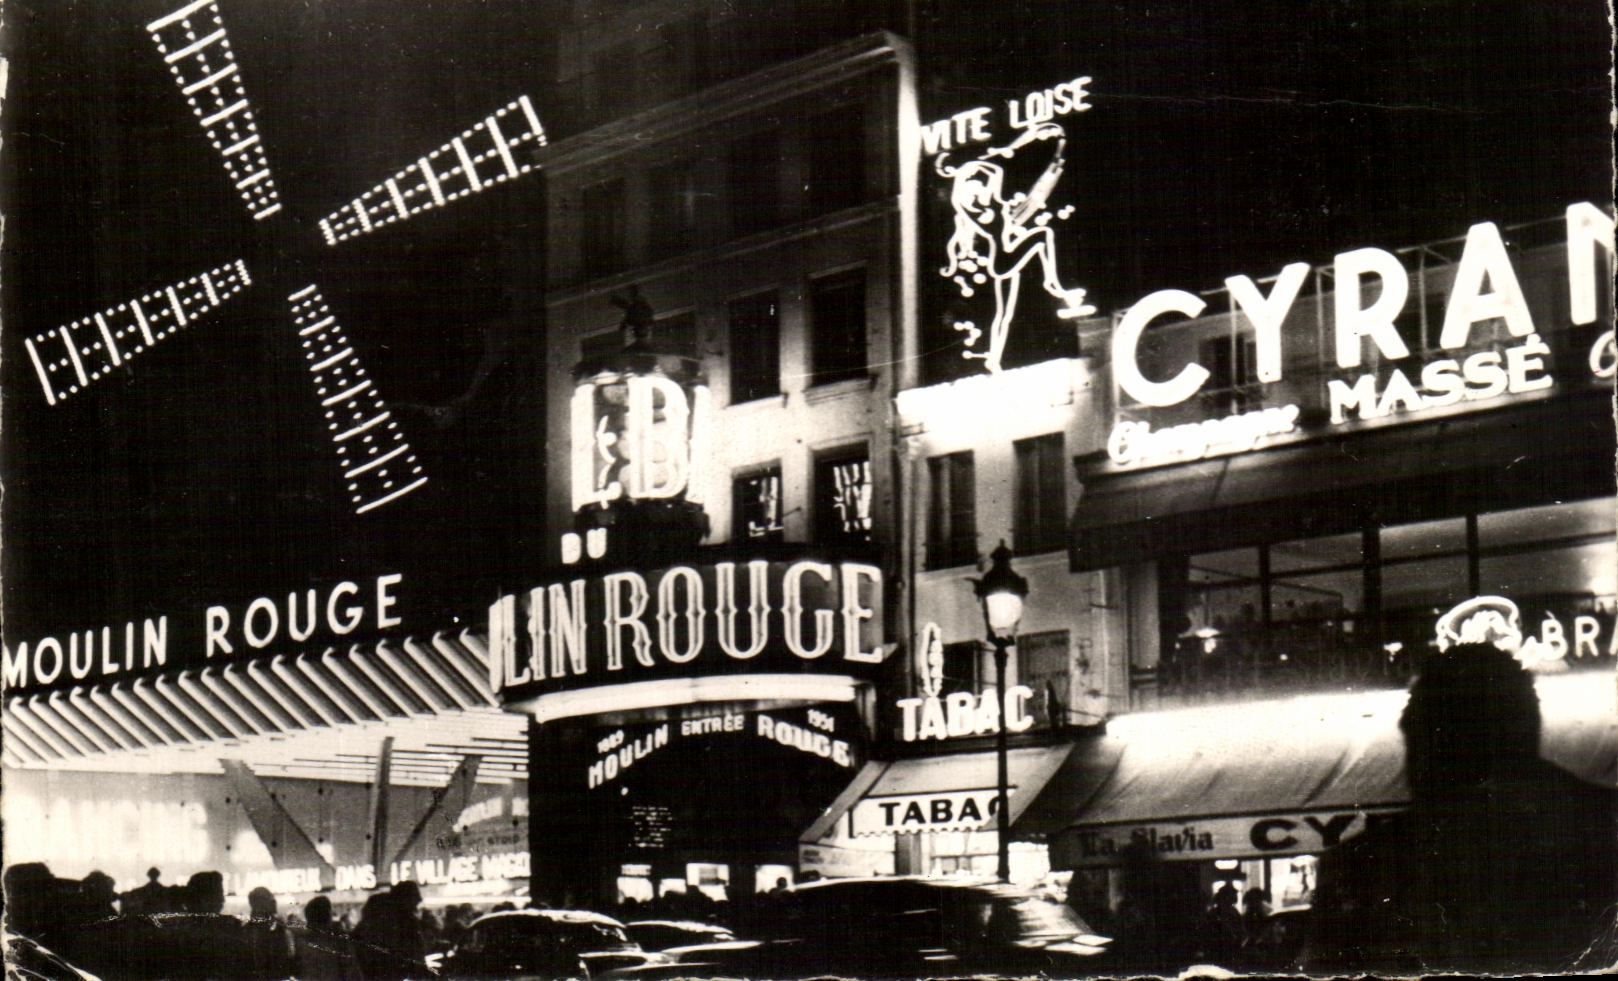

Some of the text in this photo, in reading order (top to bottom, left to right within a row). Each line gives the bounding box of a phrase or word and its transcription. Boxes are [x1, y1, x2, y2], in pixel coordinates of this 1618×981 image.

[1328, 333, 1553, 425] MASSÉ
[1, 574, 402, 690] MOULIN ROUGE
[489, 560, 884, 693] LIN ROUGE
[588, 713, 851, 790] MOULIN ROUGE
[681, 711, 745, 736] ENTRÉE
[896, 684, 1034, 742] TABAC
[416, 856, 478, 884] VILLAGE
